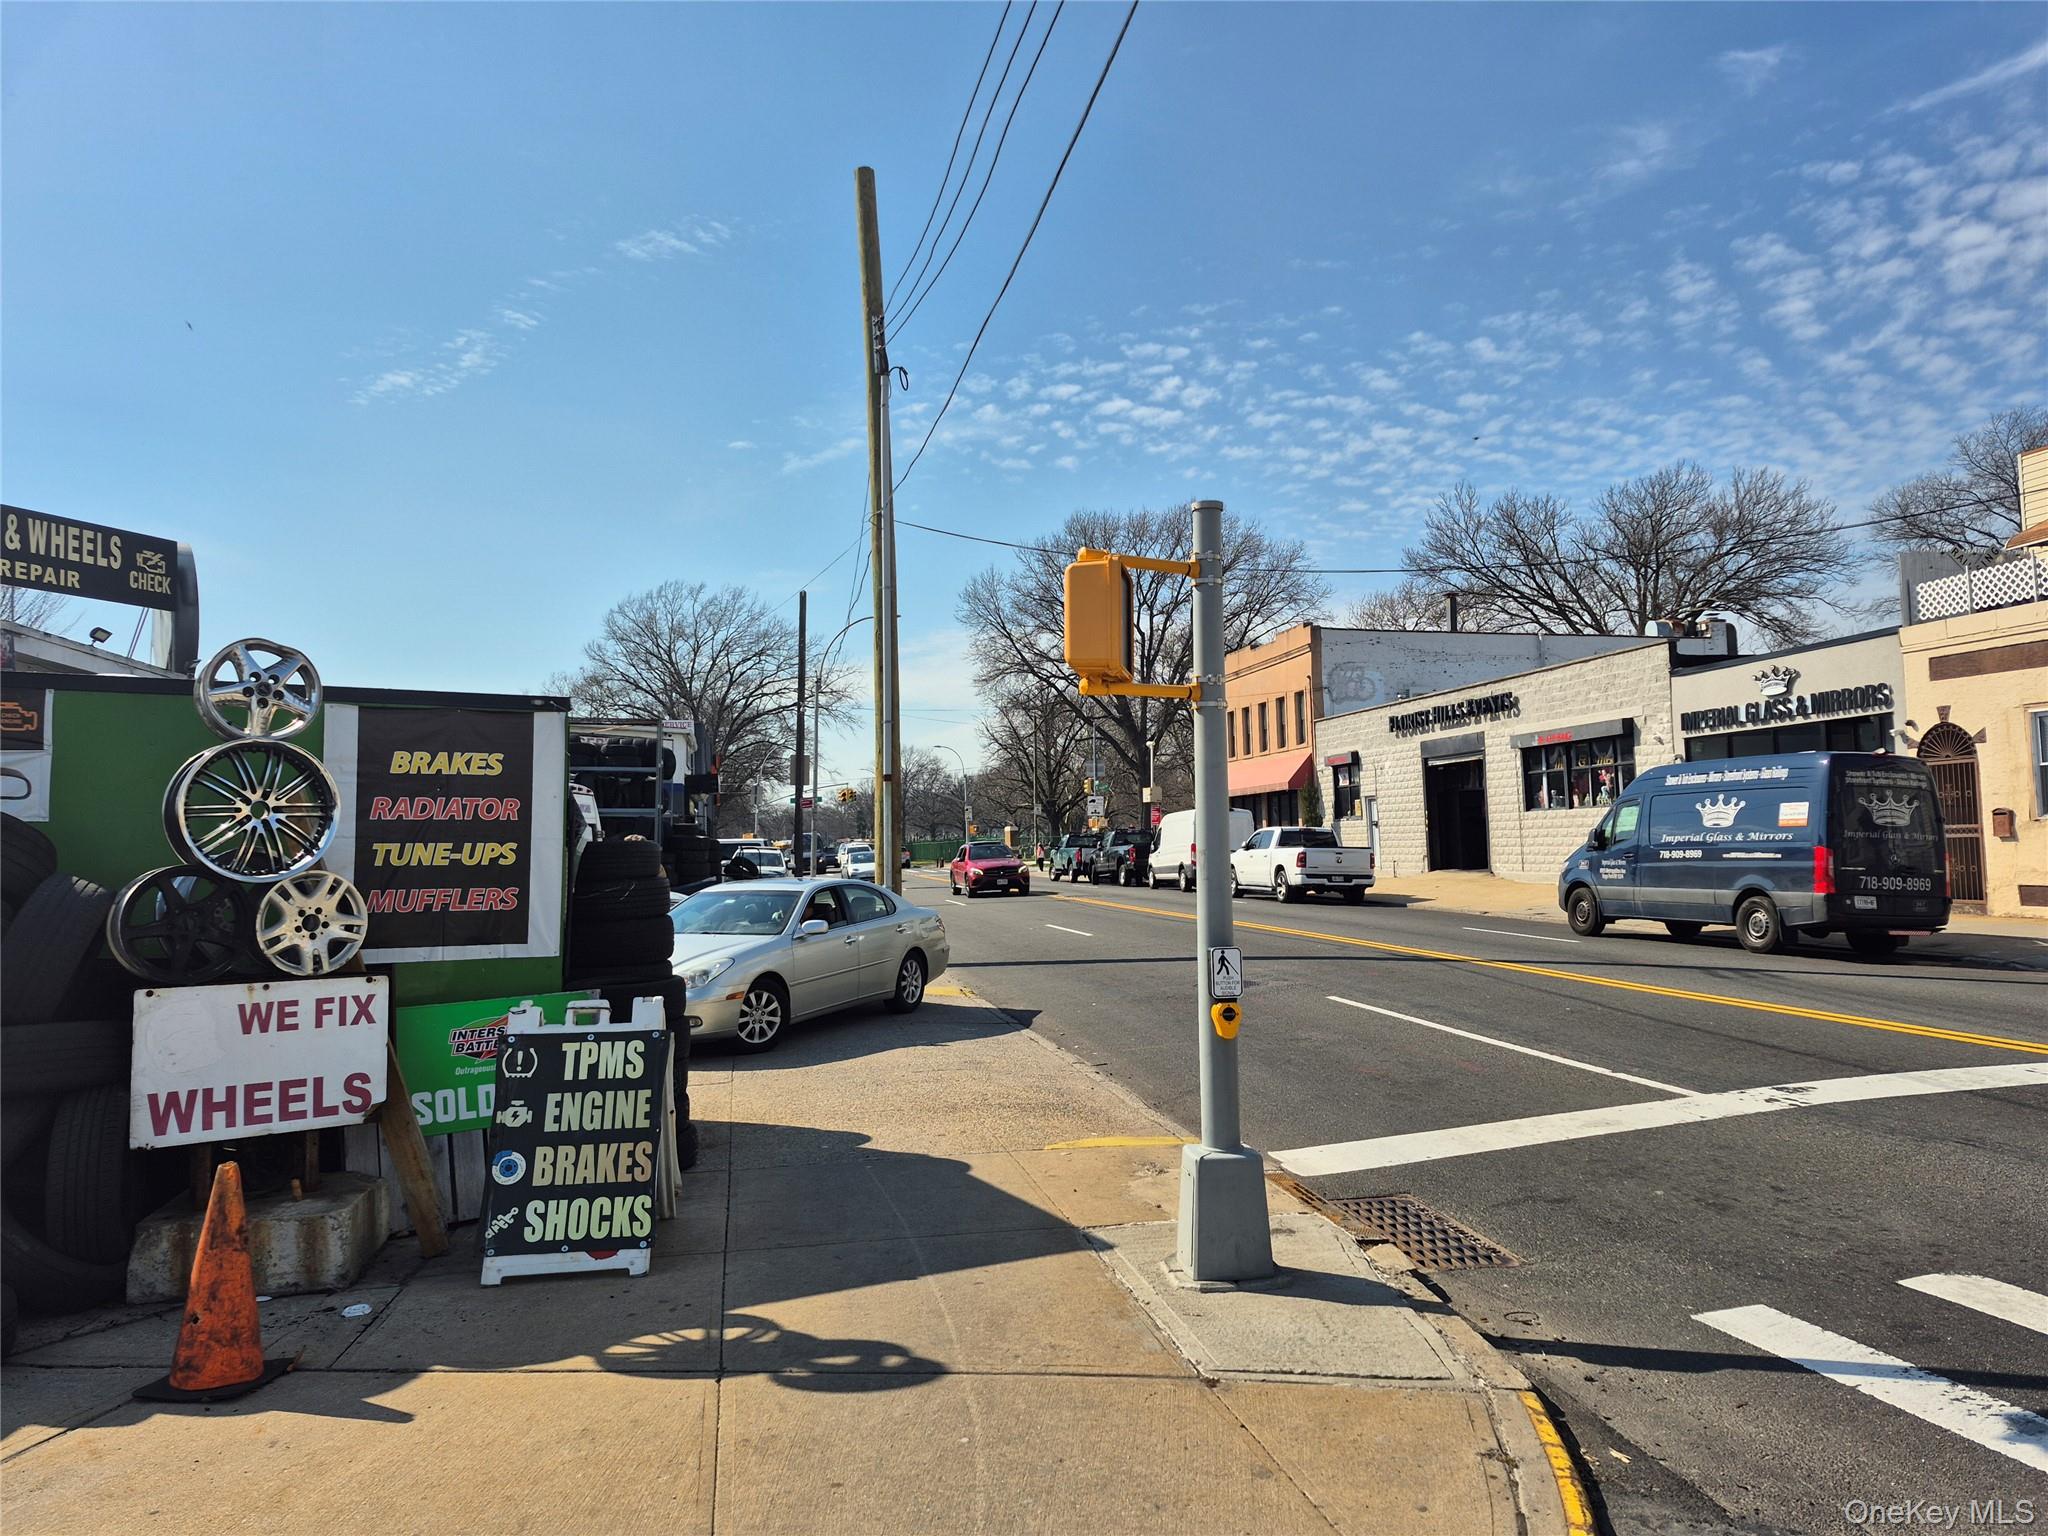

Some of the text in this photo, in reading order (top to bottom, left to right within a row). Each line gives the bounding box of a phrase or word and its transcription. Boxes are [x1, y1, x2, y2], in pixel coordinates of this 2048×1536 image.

[5, 513, 122, 570] & WHEELS
[0, 558, 80, 588] REPAIR
[129, 570, 172, 595] CHECK
[1681, 683, 1891, 731] IMPERIAL GLASS & MIRRORS
[390, 751, 504, 776] BRAKES
[369, 796, 520, 821] RADIATOR
[1661, 832, 1793, 845] Imperial Glass & Mirrors
[1843, 829, 1880, 839] Imperial
[372, 842, 517, 867] TUNE-UPS
[1660, 850, 1702, 859] 718-909-8969
[1860, 876, 1931, 891] 718-909-8969
[367, 887, 519, 913] MUFFLERS
[238, 993, 376, 1035] WE FIX
[452, 1026, 505, 1041] INTERS
[455, 1039, 499, 1053] BATTE
[562, 1040, 645, 1080] TPMS
[147, 1072, 372, 1136] WHEELS
[411, 1084, 496, 1126] SOLD
[544, 1089, 652, 1132] ENGINE
[532, 1141, 653, 1187] BRAKES
[524, 1195, 652, 1243] SHOCKS
